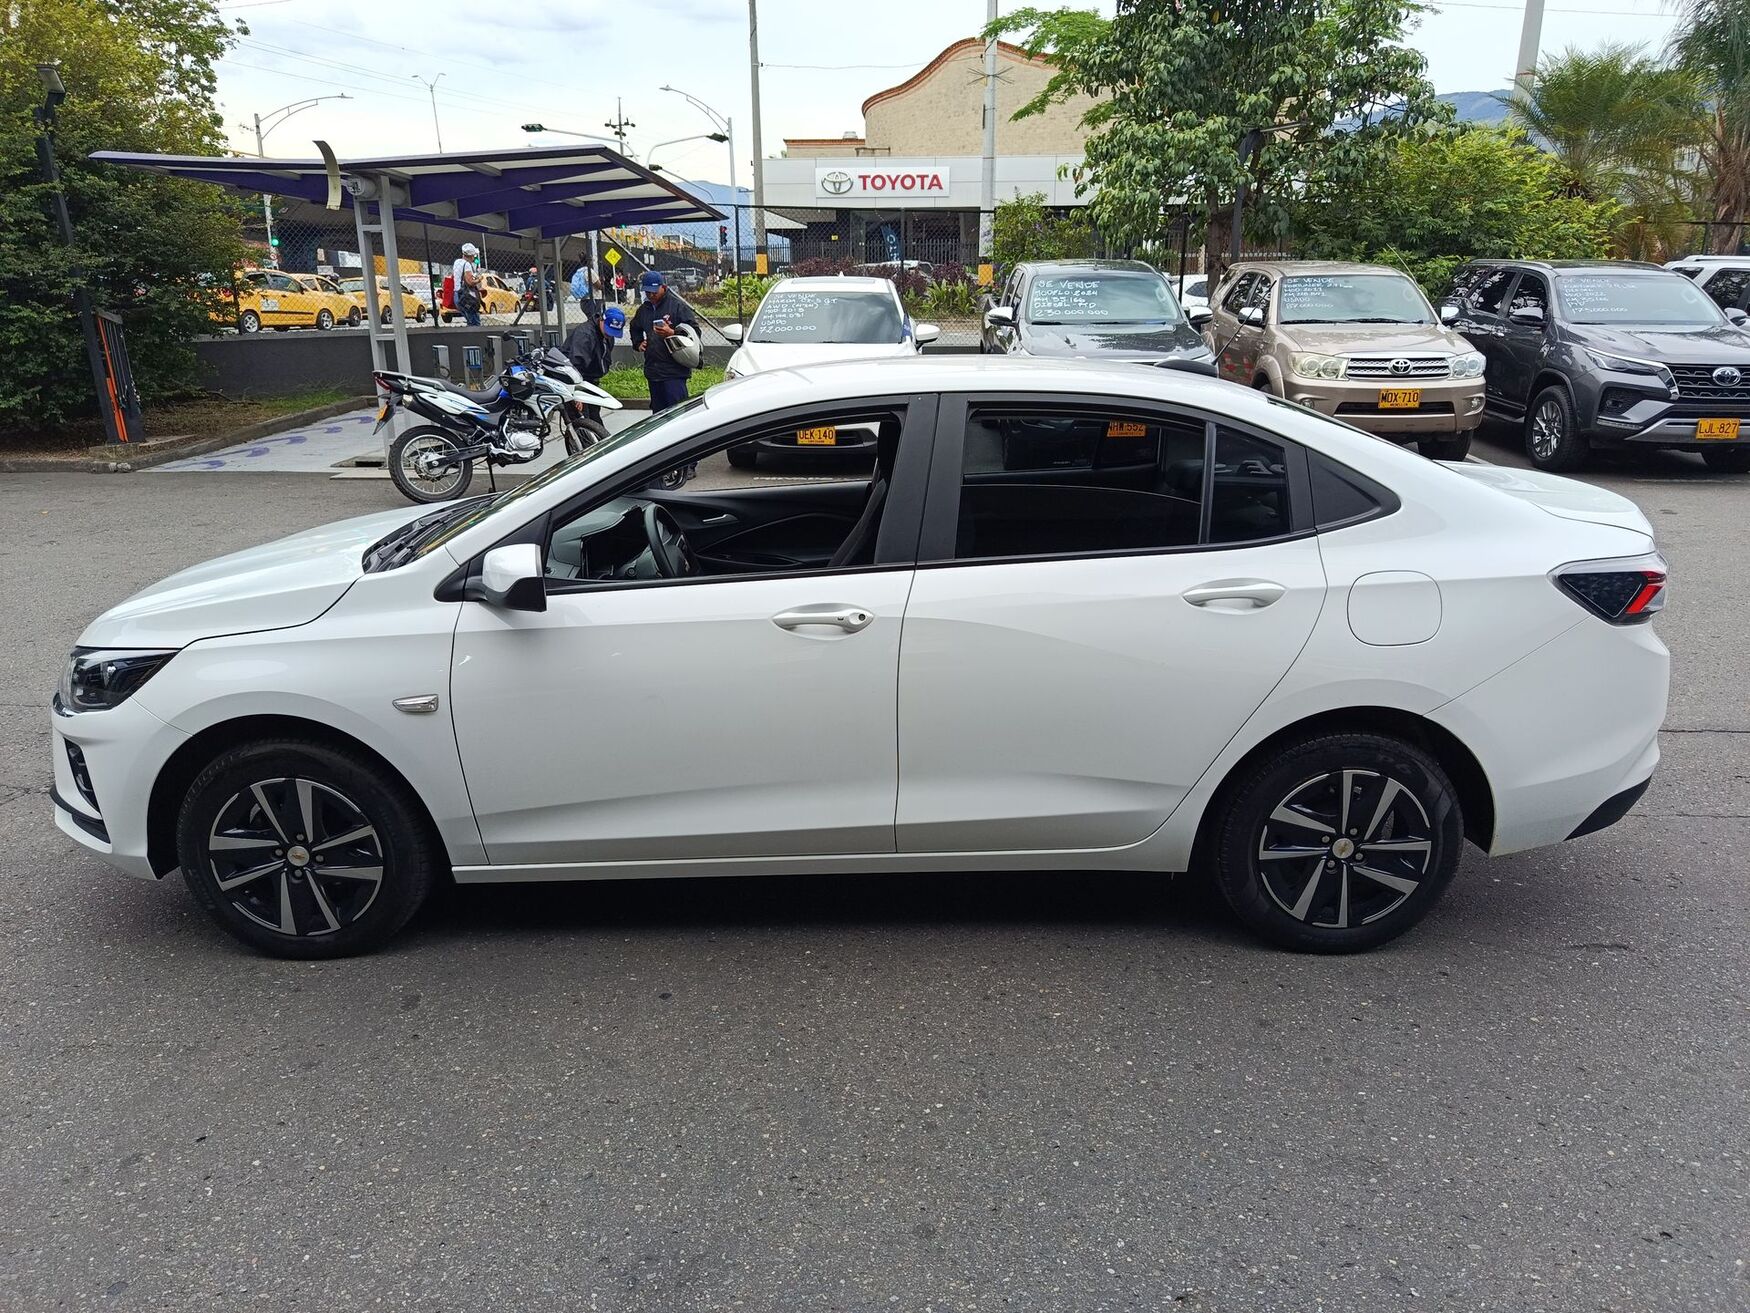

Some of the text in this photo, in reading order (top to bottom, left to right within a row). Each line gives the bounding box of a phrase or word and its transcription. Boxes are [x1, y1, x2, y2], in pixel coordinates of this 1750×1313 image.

[858, 174, 943, 191] TOYOTA
[1038, 279, 1100, 289] SE VENDE
